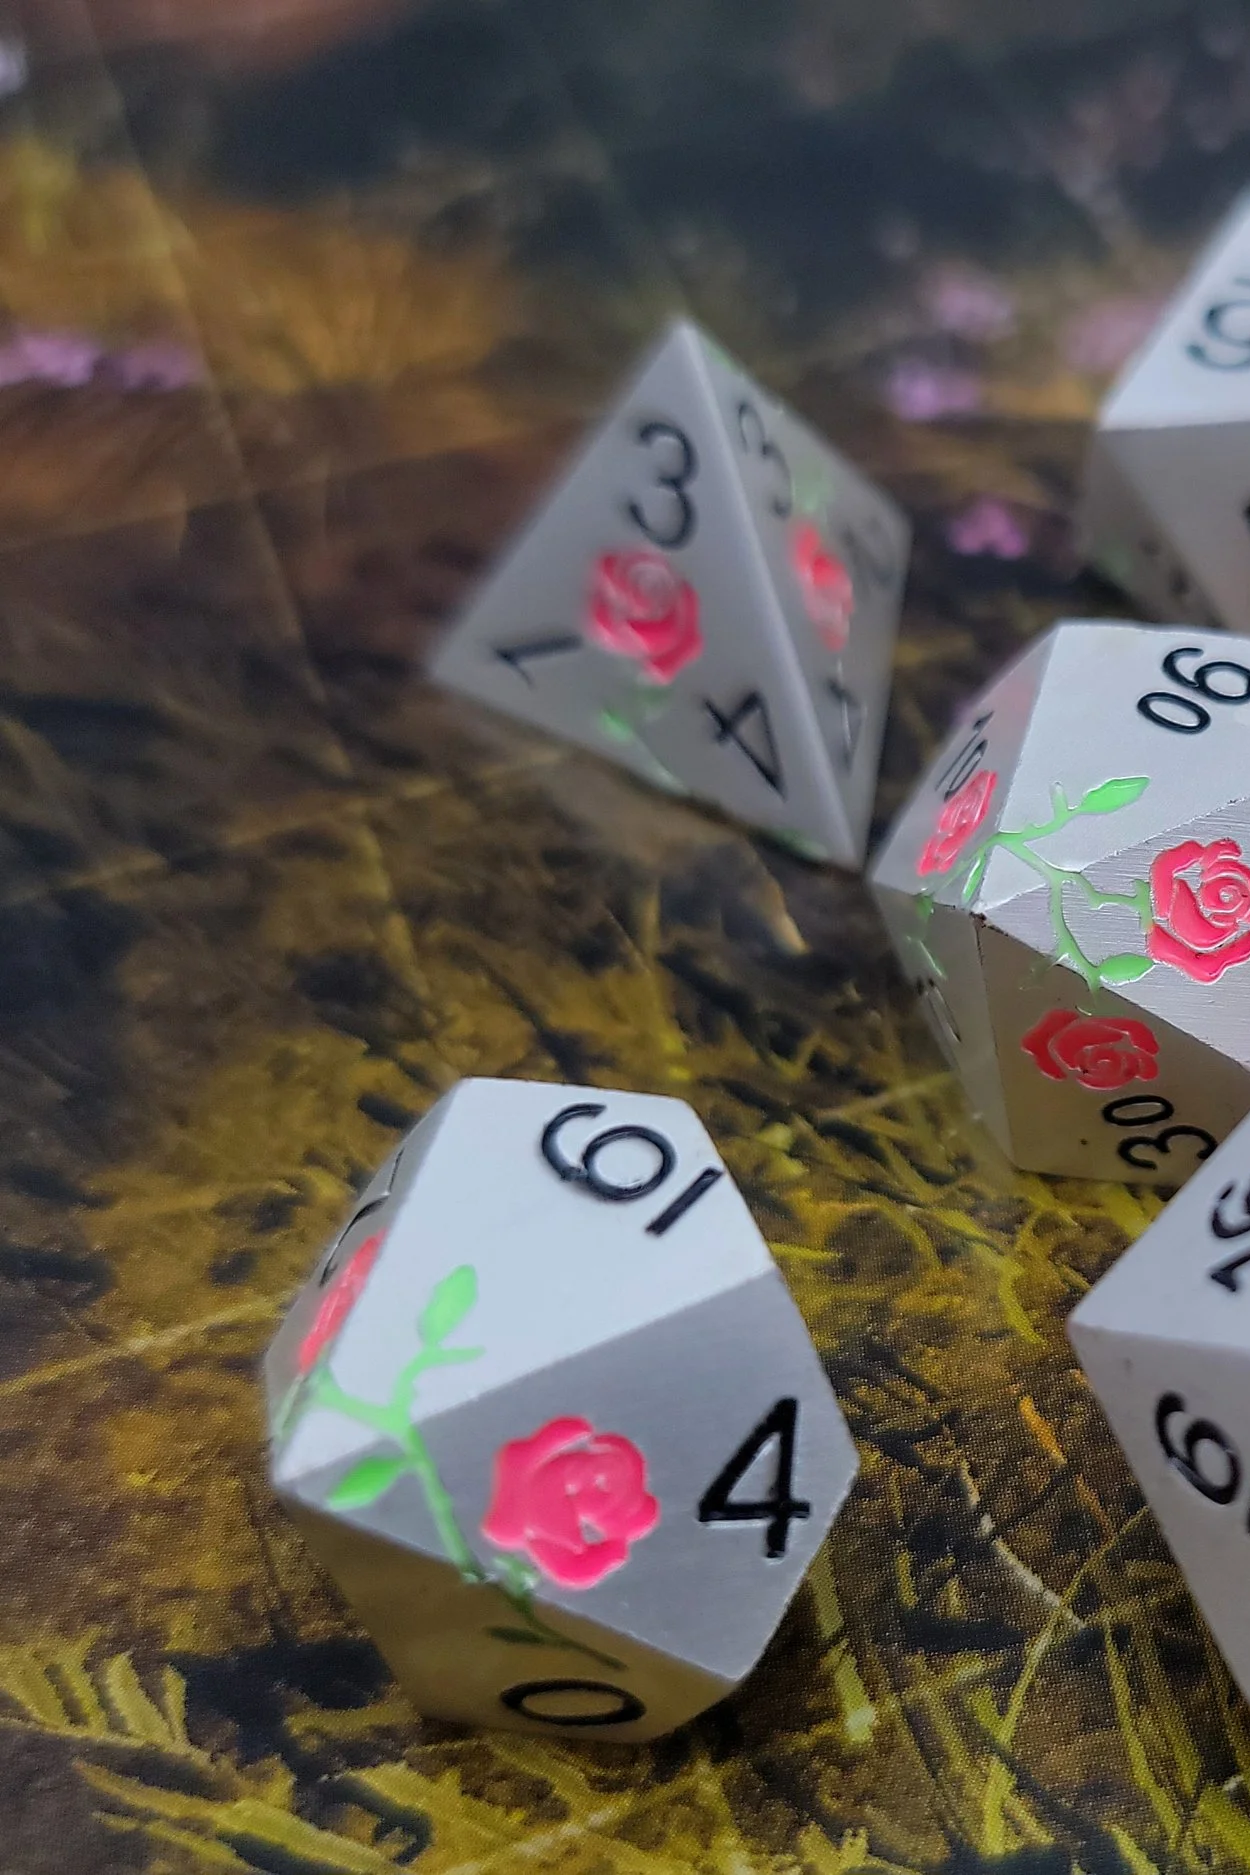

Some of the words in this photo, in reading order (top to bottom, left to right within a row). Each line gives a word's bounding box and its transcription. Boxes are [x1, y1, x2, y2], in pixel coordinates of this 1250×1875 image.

[624, 421, 698, 552] 3
[738, 400, 793, 520] 3
[490, 632, 584, 687] 1
[699, 690, 786, 801] 4
[1102, 1094, 1218, 1171] 30
[696, 1396, 811, 1558] 4
[500, 1678, 647, 1727] 0
